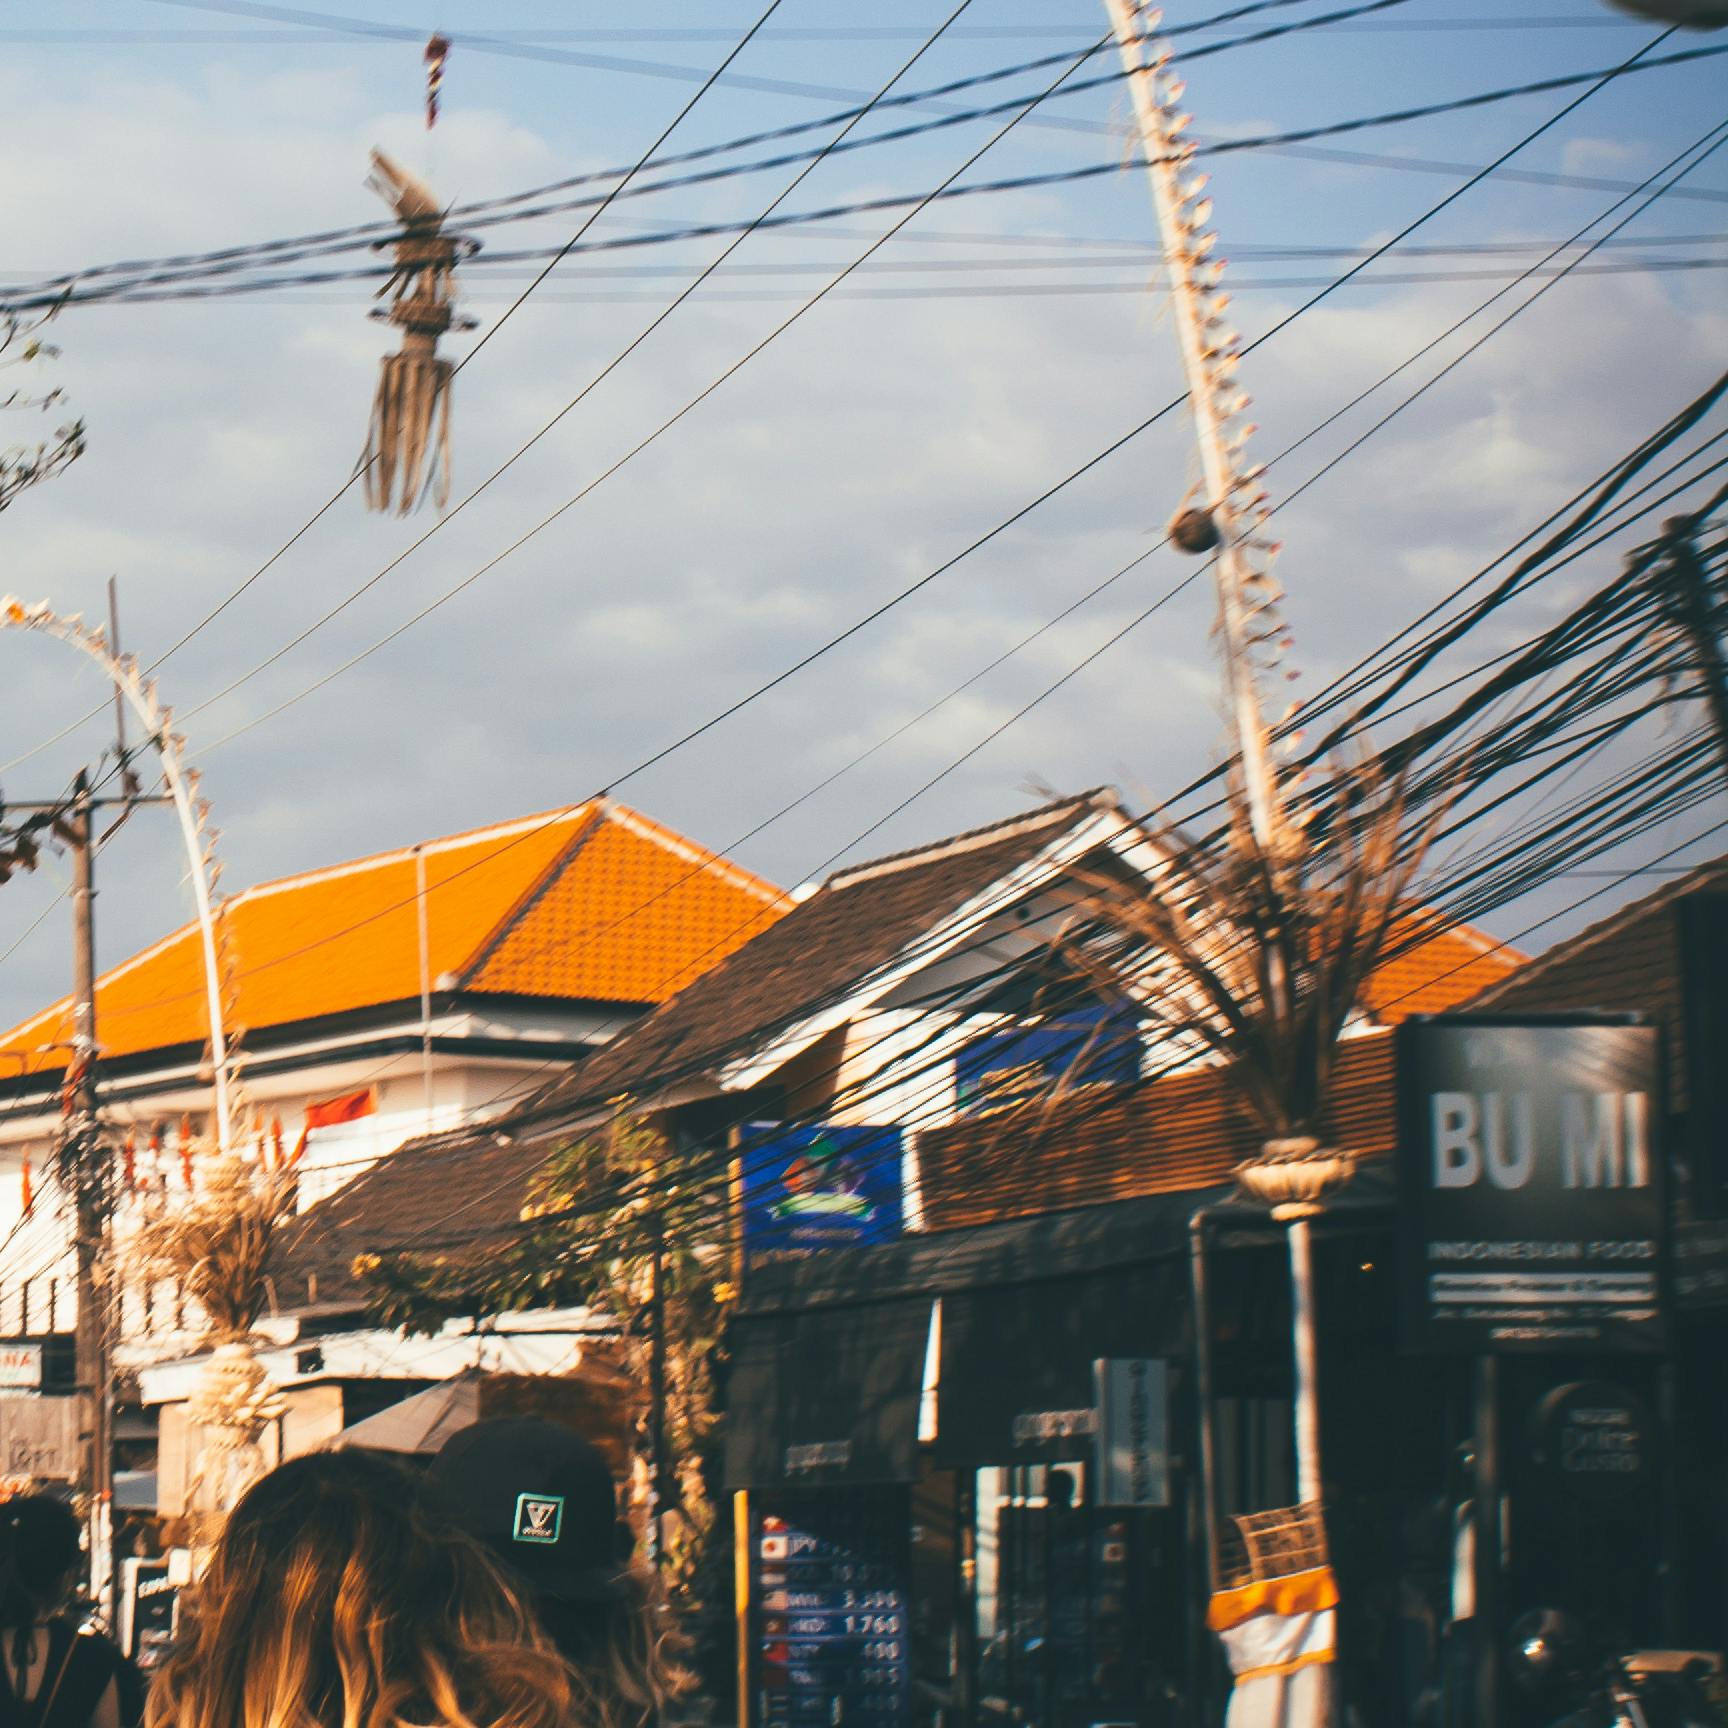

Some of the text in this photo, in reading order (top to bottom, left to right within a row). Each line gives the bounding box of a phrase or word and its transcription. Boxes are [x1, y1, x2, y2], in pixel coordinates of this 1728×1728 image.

[1430, 1090, 1651, 1190] BU MI
[1426, 1240, 1584, 1260] INDONESIAN
[1586, 1239, 1658, 1260] FOOD
